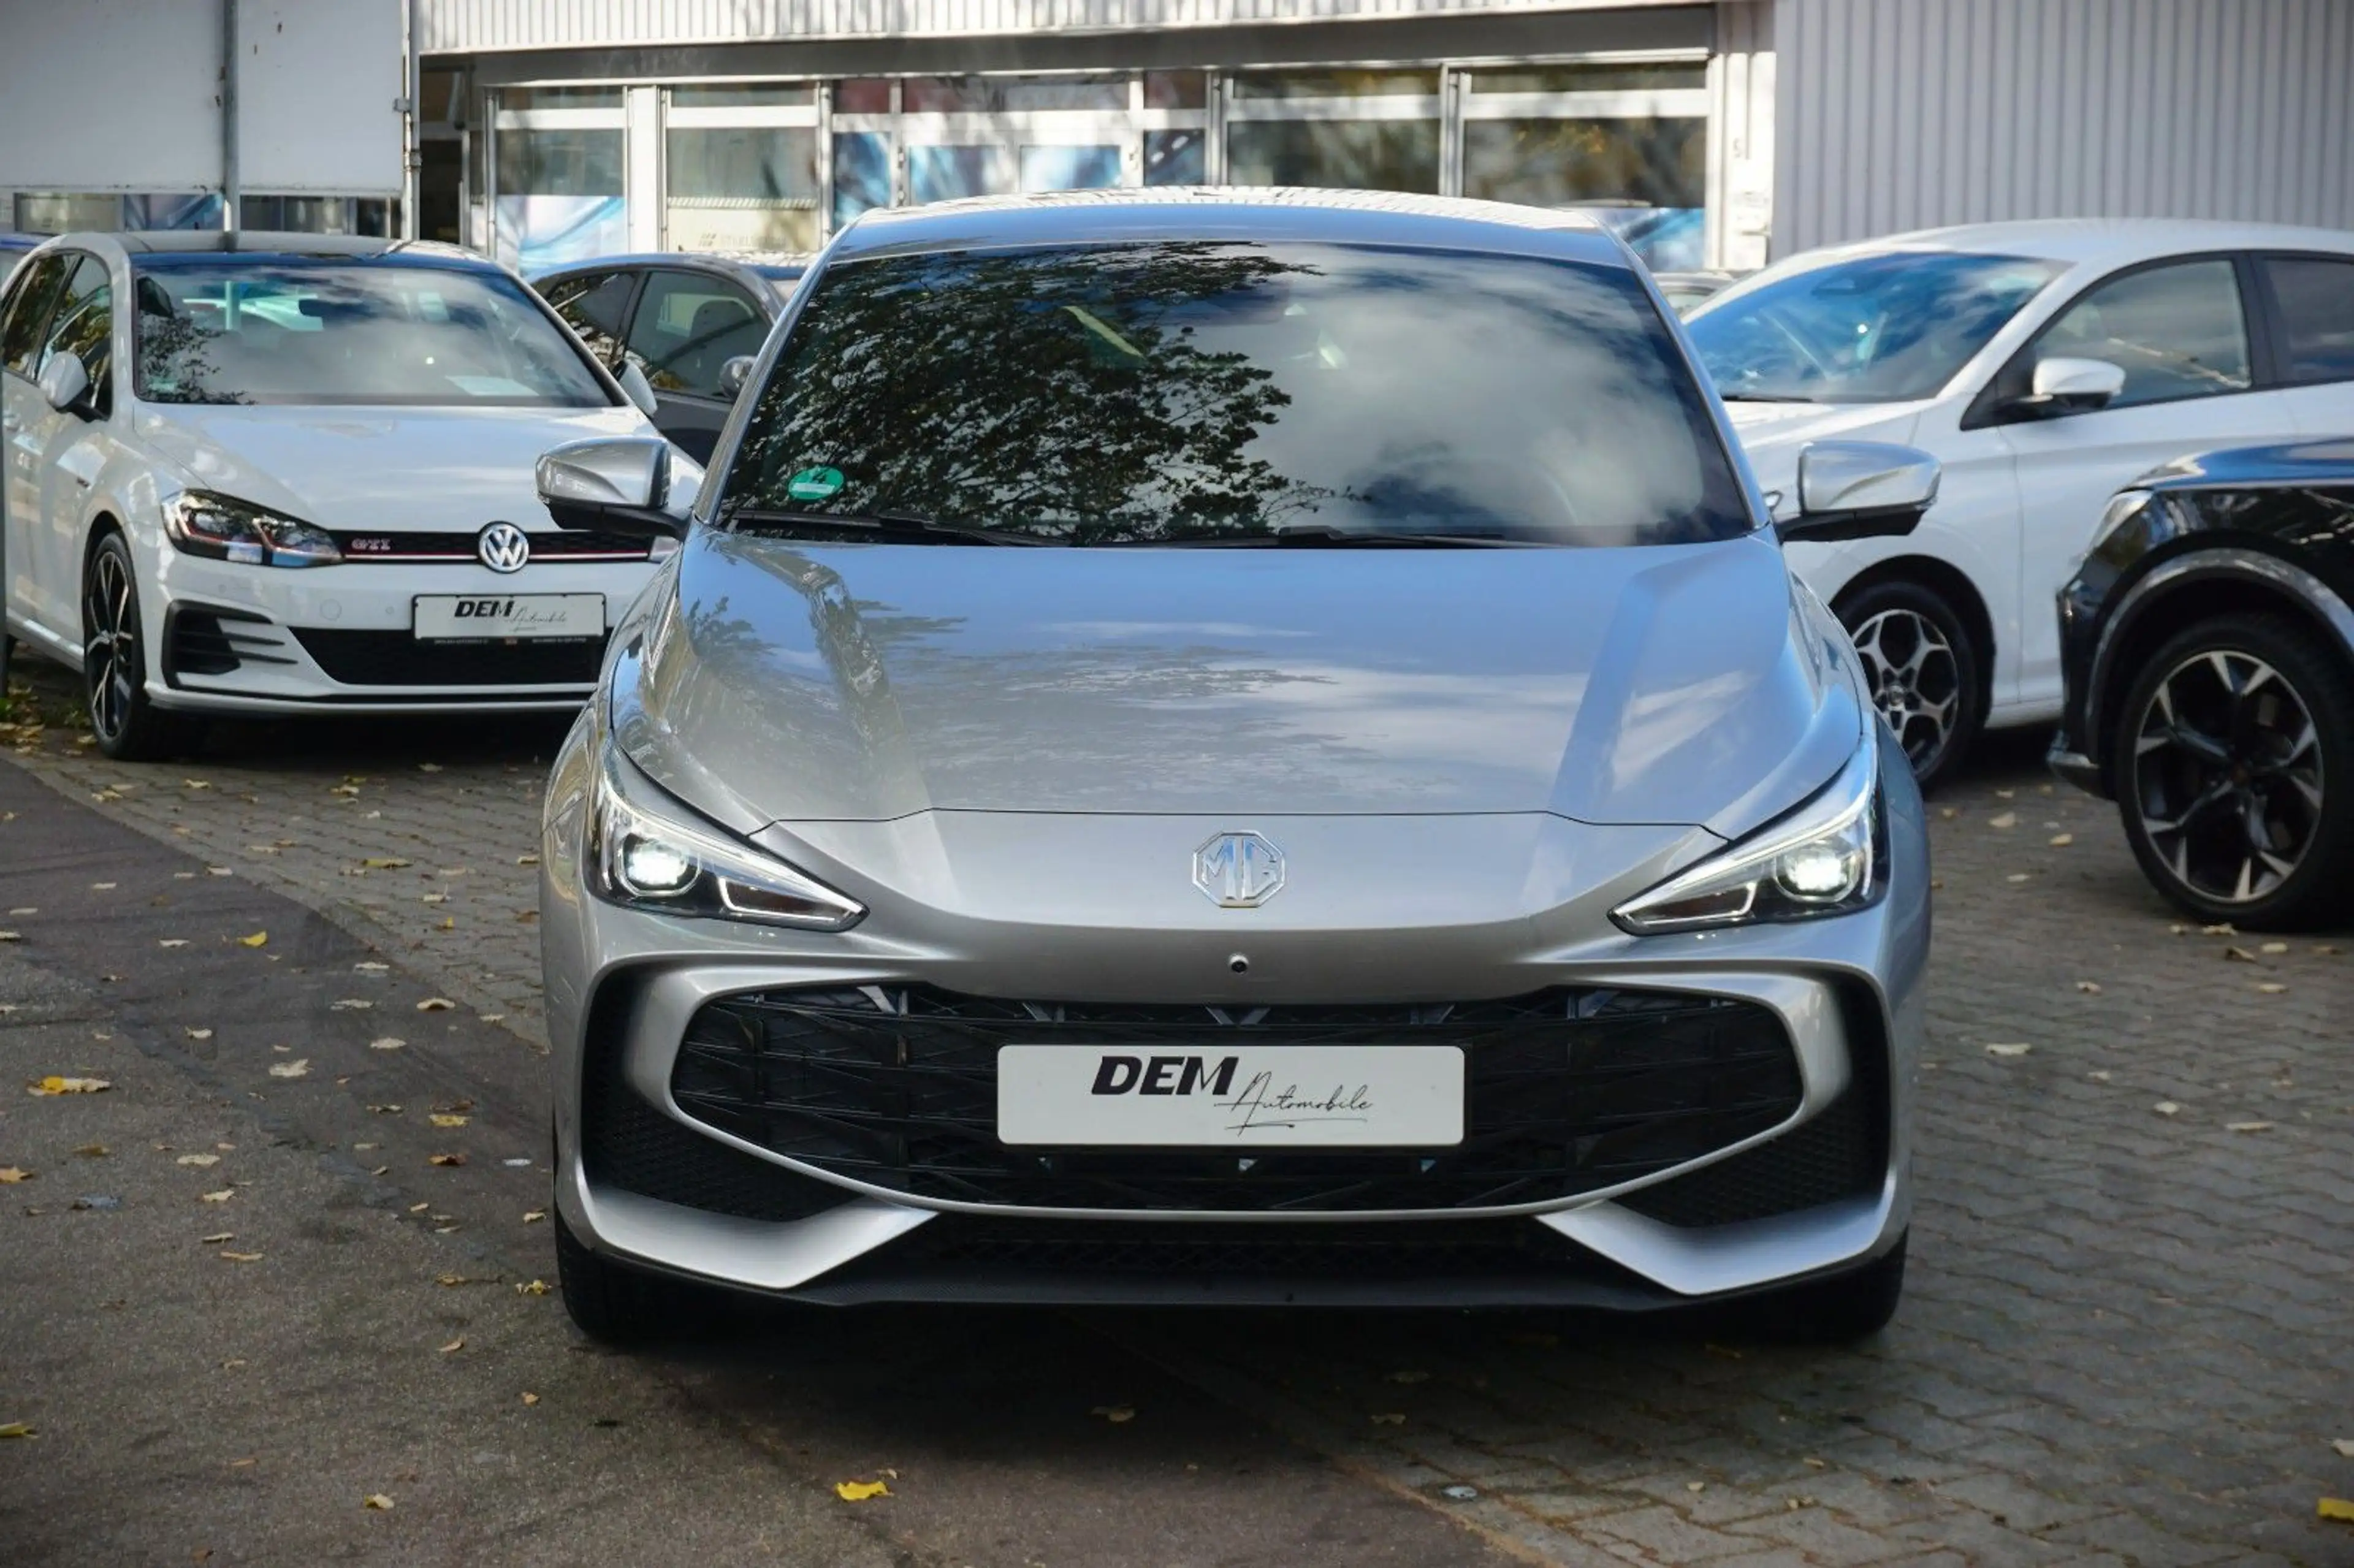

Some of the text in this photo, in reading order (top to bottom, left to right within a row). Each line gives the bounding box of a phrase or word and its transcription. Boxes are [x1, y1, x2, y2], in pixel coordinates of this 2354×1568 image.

[812, 468, 829, 484] 4
[351, 538, 391, 550] GTI
[481, 524, 528, 571] VW
[454, 600, 514, 617] DEM
[1200, 837, 1278, 901] MG
[1091, 1056, 1373, 1137] DEM Automobile
